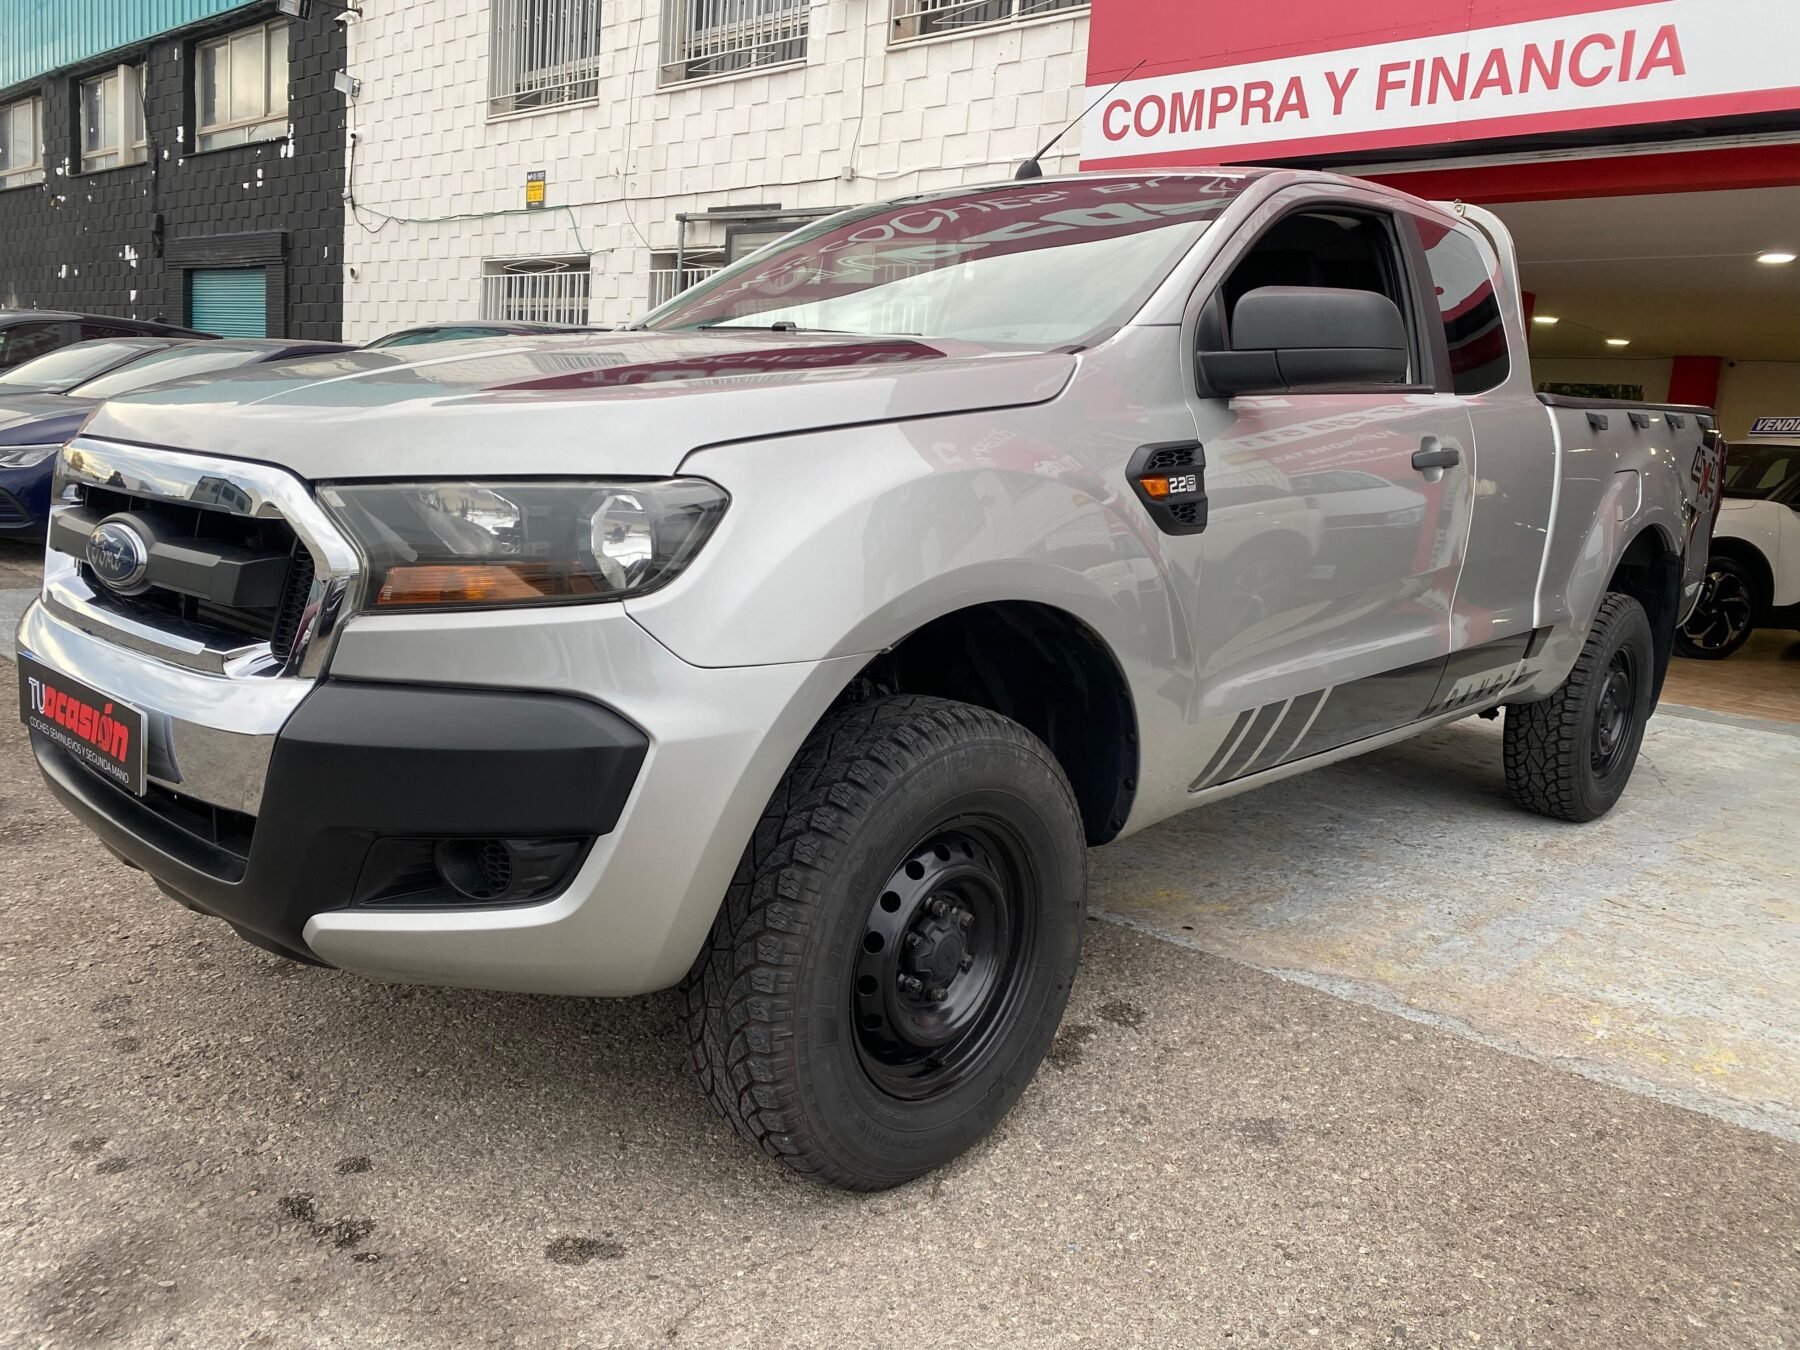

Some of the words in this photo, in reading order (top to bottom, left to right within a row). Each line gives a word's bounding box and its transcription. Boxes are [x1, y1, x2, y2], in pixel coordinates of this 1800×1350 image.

[1102, 76, 1309, 141] COMPRA
[1324, 68, 1358, 116] Y
[1375, 24, 1686, 111] FINANCIA
[29, 715, 50, 736] COCHES
[85, 748, 112, 773] SEGUNDA
[111, 764, 129, 784] MANO
